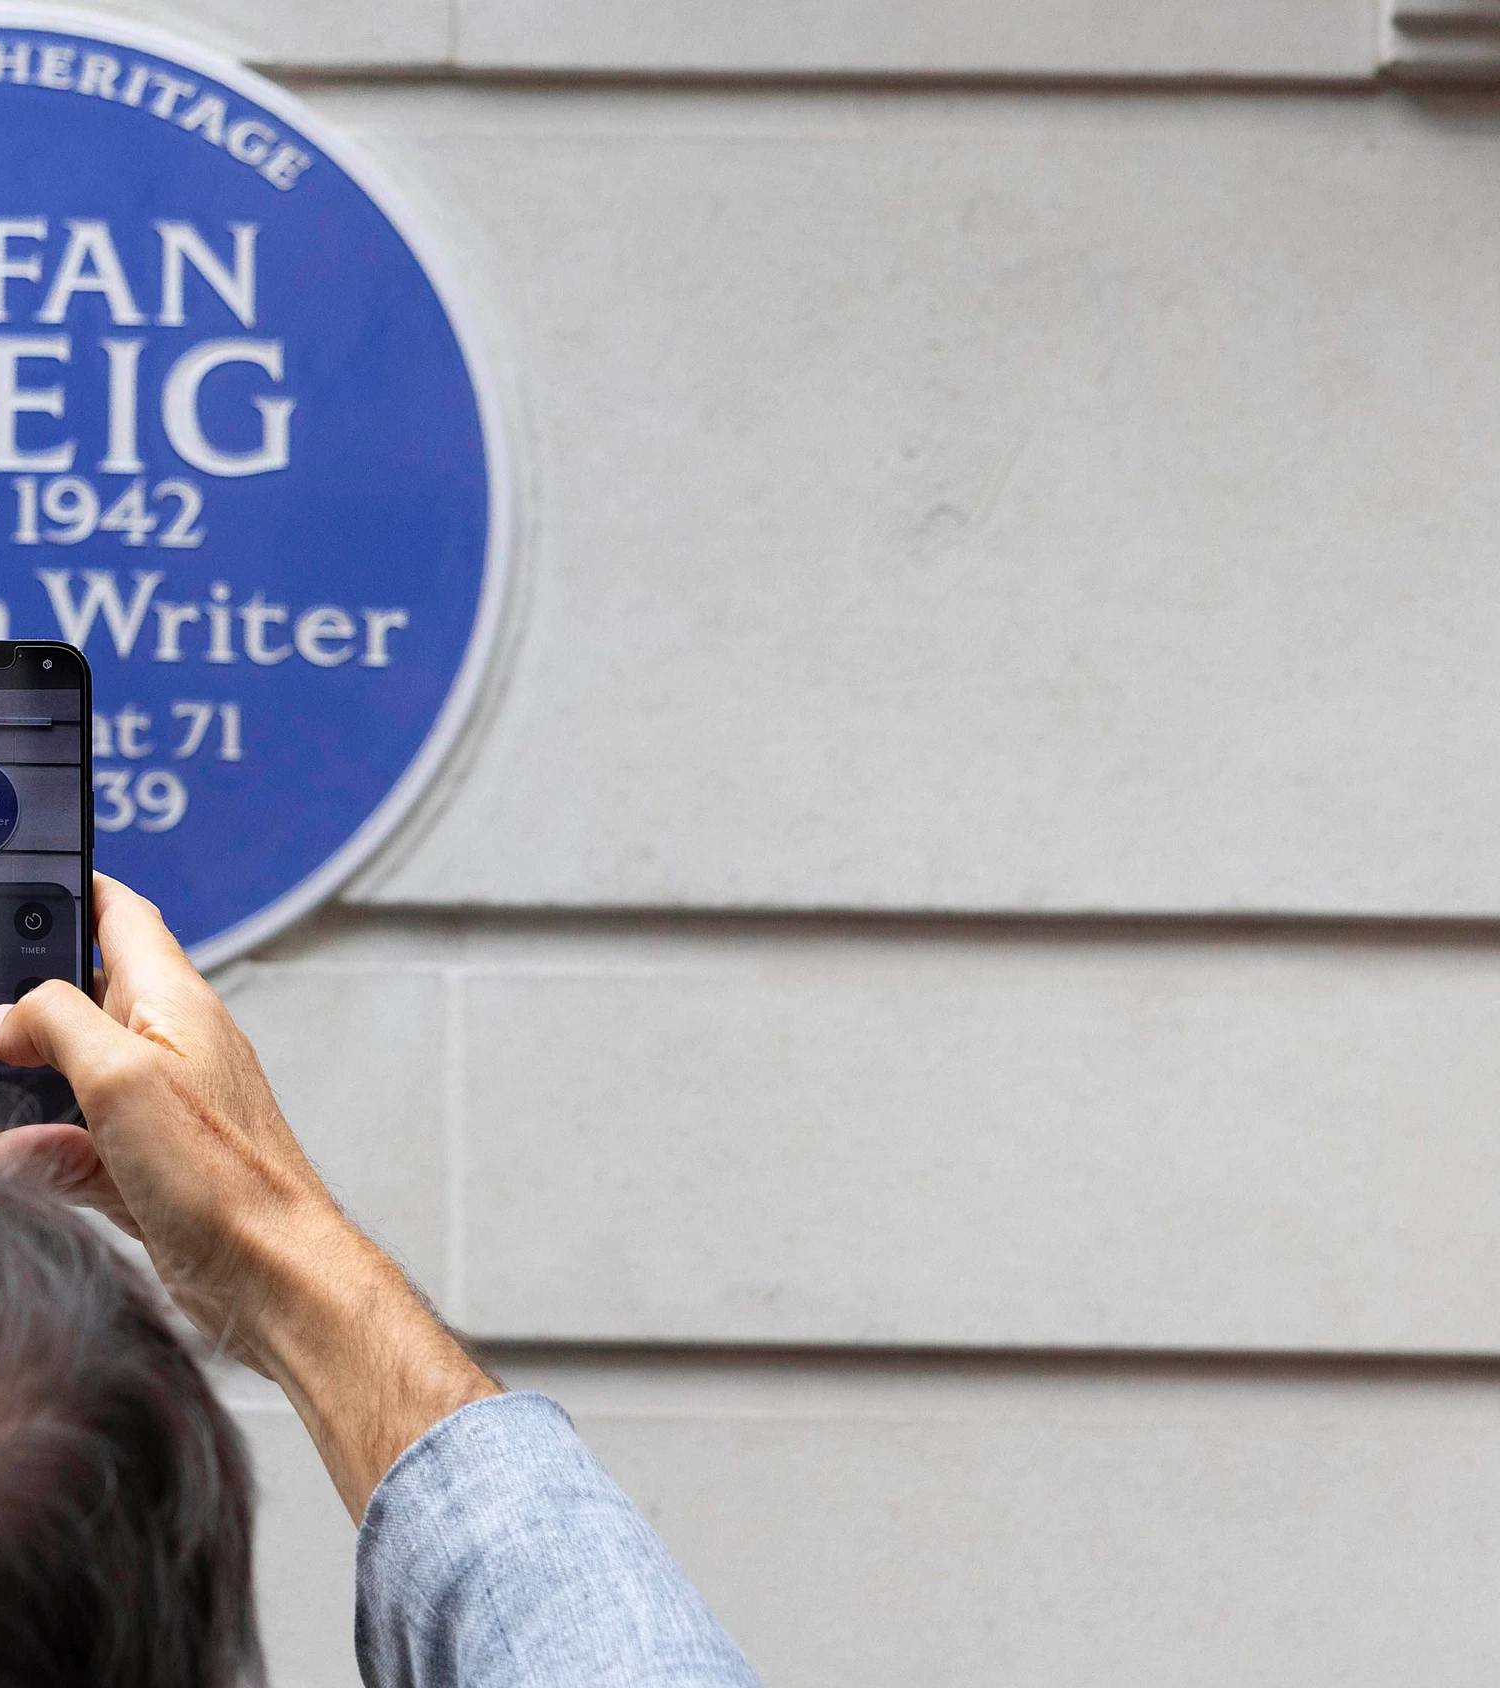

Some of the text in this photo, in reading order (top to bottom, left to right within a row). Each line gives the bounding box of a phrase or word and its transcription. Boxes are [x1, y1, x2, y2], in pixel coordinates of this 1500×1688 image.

[37, 568, 410, 667] Writer
[171, 701, 242, 762] 71
[21, 946, 47, 955] TIMER
